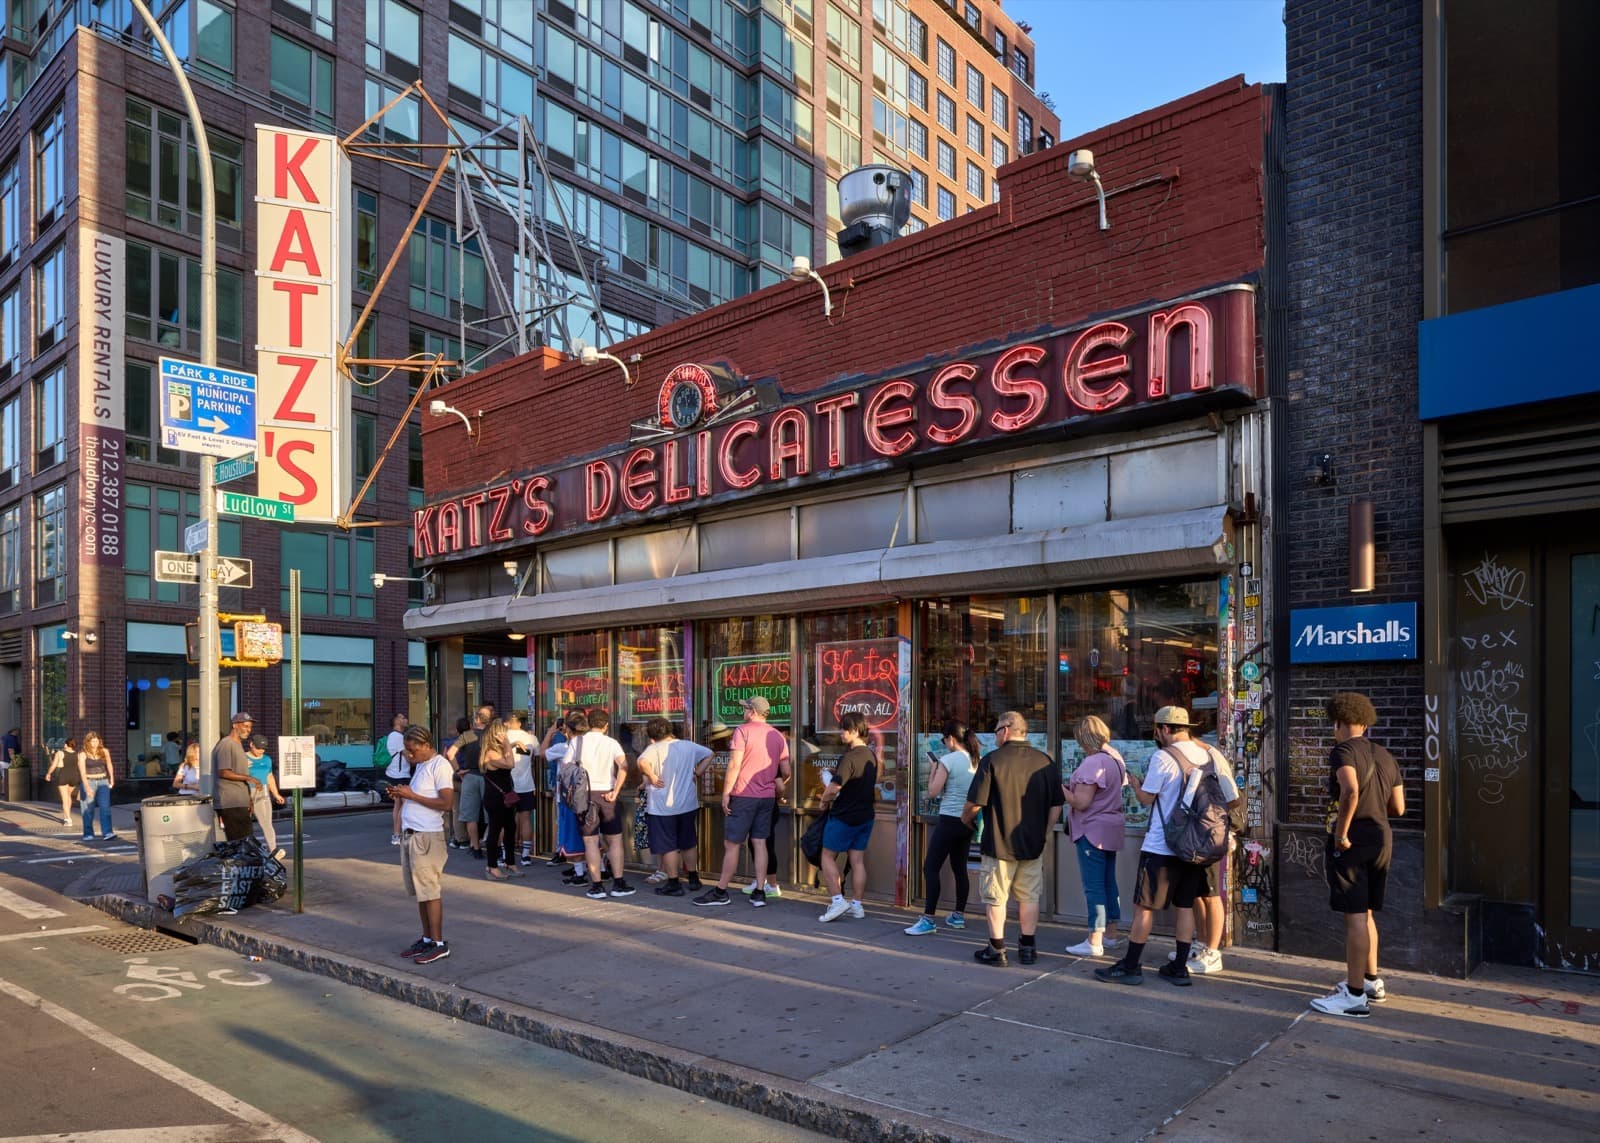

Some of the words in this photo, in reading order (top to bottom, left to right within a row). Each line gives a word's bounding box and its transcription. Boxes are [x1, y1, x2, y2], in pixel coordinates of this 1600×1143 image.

[94, 238, 112, 321] LUXURY
[264, 133, 322, 506] KATZ'S
[93, 325, 112, 419] RENTALS
[170, 365, 202, 379] PARK
[208, 372, 217, 382] &
[222, 375, 248, 388] RIDE
[169, 393, 190, 419] P
[197, 385, 251, 406] MUNICIPAL
[197, 398, 242, 416] PARKING
[219, 457, 247, 481] Houston
[82, 436, 99, 556] theludlownyc.com
[102, 439, 119, 556] 212.387.0188
[223, 494, 277, 518] Ludlow
[282, 503, 292, 515] St
[414, 476, 550, 559] KATZ'S
[167, 561, 194, 574] ONE
[1295, 620, 1410, 647] Marshalls
[723, 661, 790, 687] KATZ'S
[874, 702, 892, 716] ALL
[1425, 695, 1440, 761] UNO
[221, 880, 253, 895] EAST
